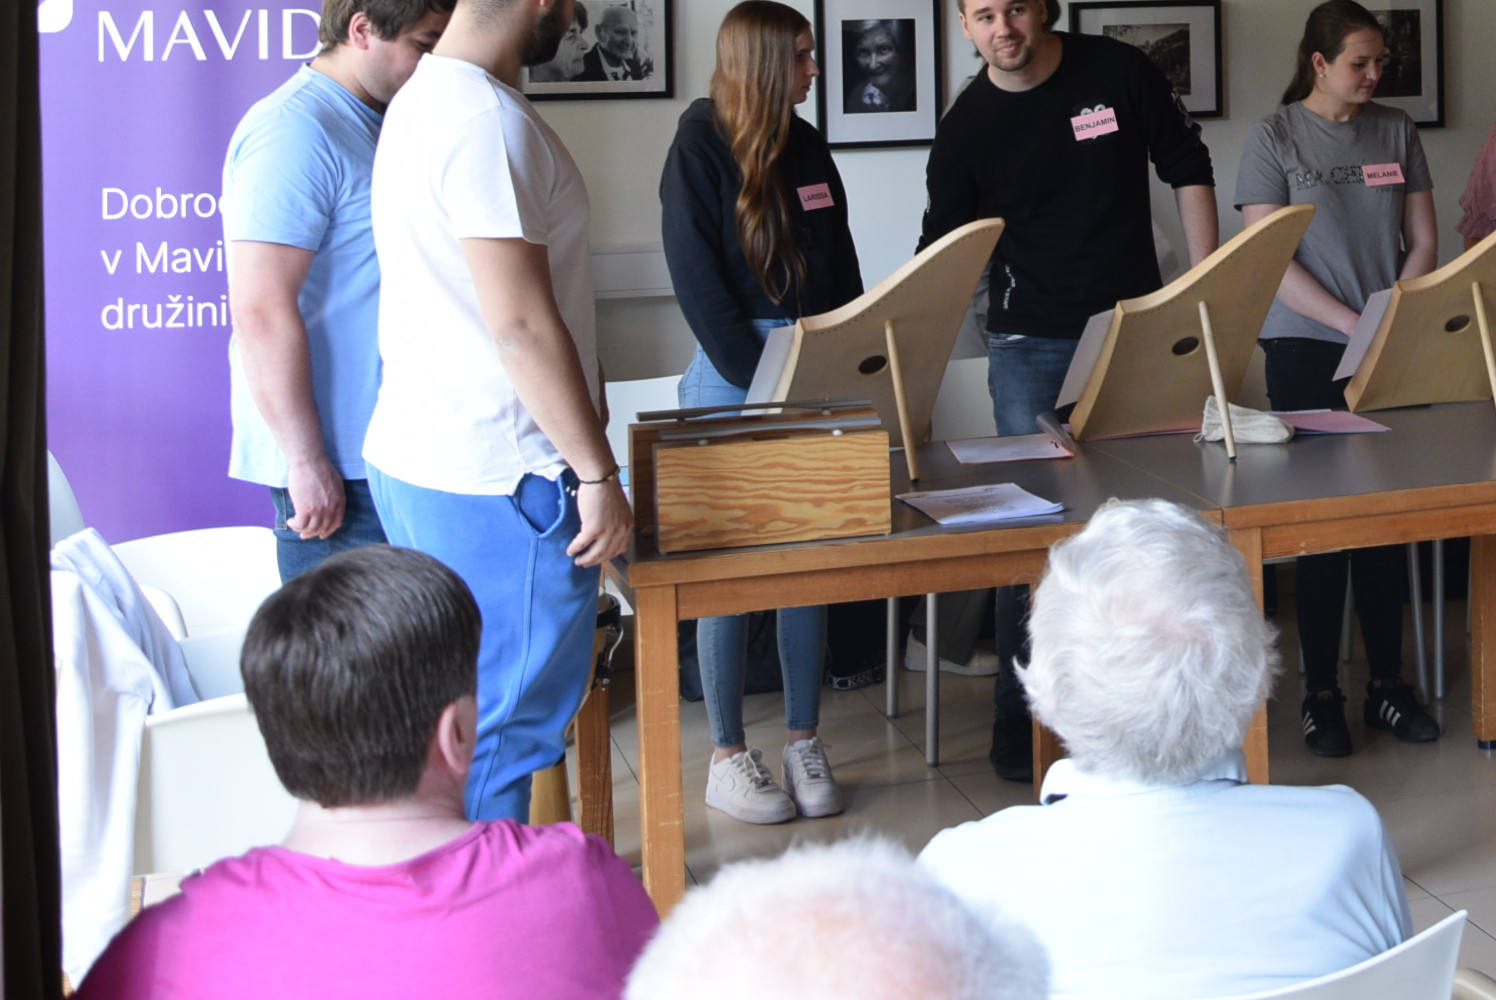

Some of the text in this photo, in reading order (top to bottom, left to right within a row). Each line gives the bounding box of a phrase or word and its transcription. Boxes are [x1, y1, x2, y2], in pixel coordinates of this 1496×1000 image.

[98, 8, 324, 63] MAVID
[1074, 116, 1116, 133] BENJAMIN
[1367, 170, 1399, 180] MELANIE
[101, 188, 223, 221] Dobro
[803, 192, 829, 202] LARISSA
[101, 249, 123, 274] v
[101, 294, 234, 331] družini
